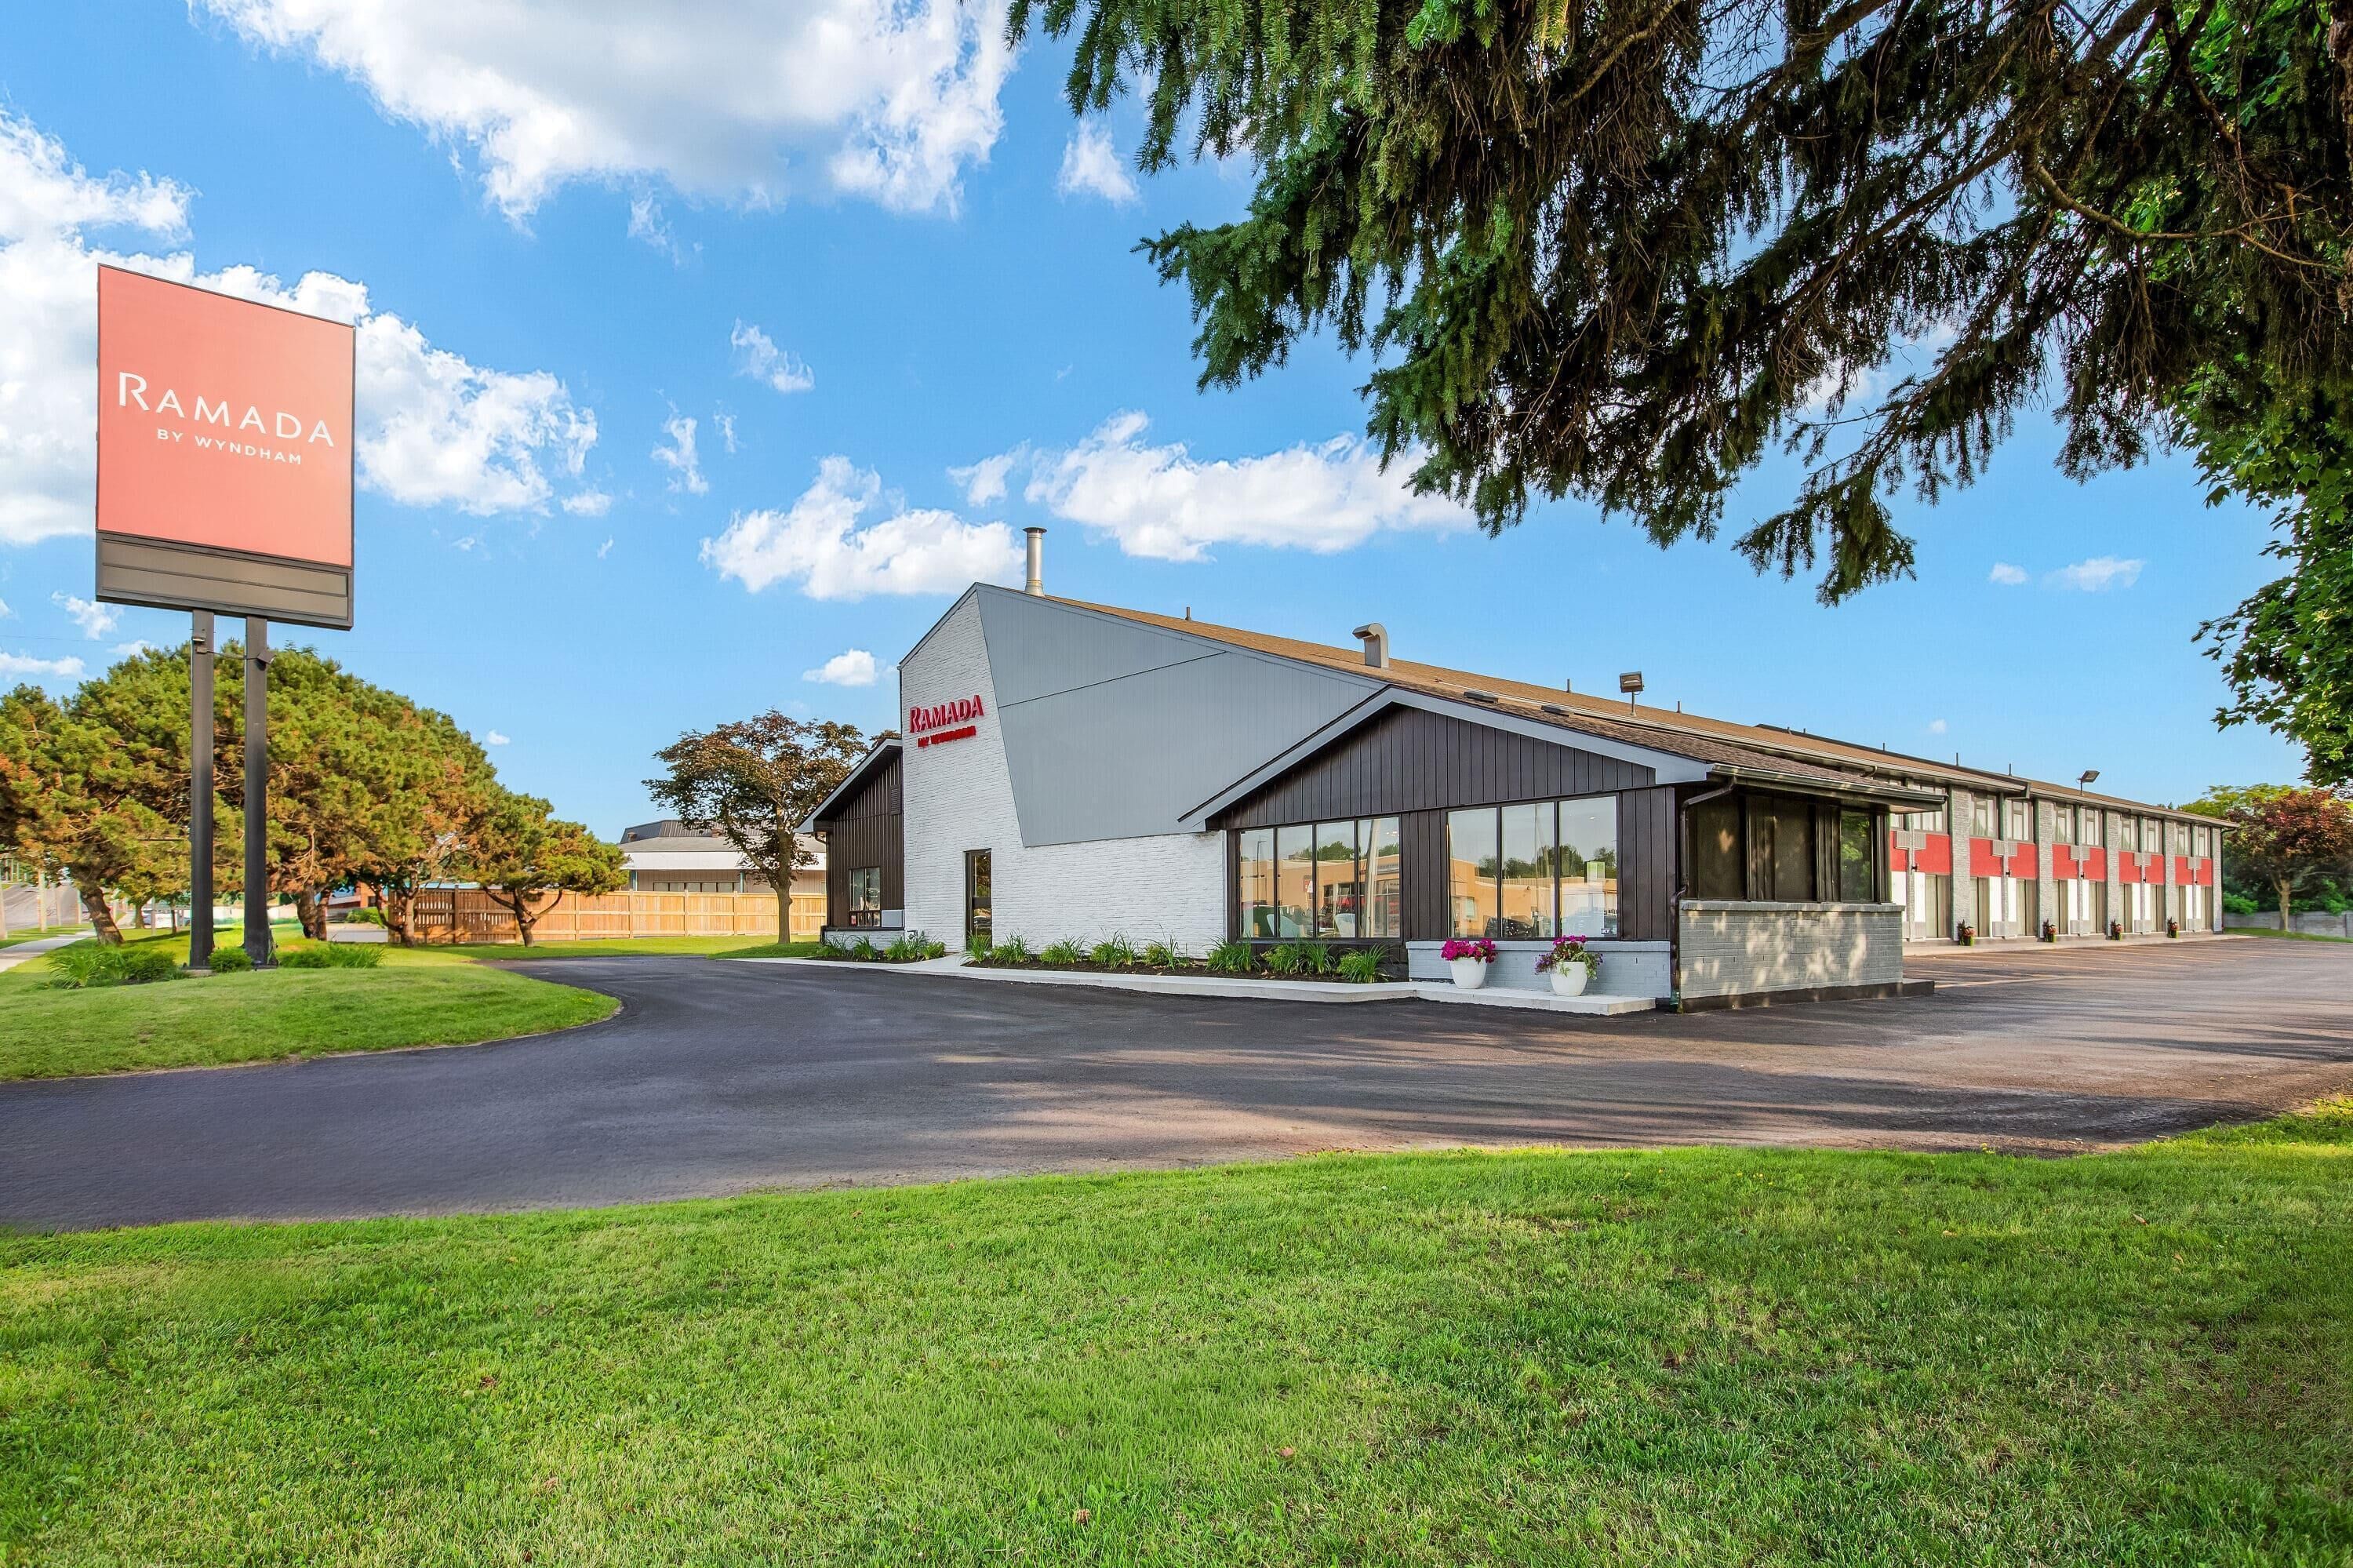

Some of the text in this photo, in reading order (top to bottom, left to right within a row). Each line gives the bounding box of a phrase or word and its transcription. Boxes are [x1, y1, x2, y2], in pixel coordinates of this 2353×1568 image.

[118, 372, 335, 447] RAMADA
[158, 428, 301, 465] BY WYNDHAM
[909, 694, 984, 733] RAMADA
